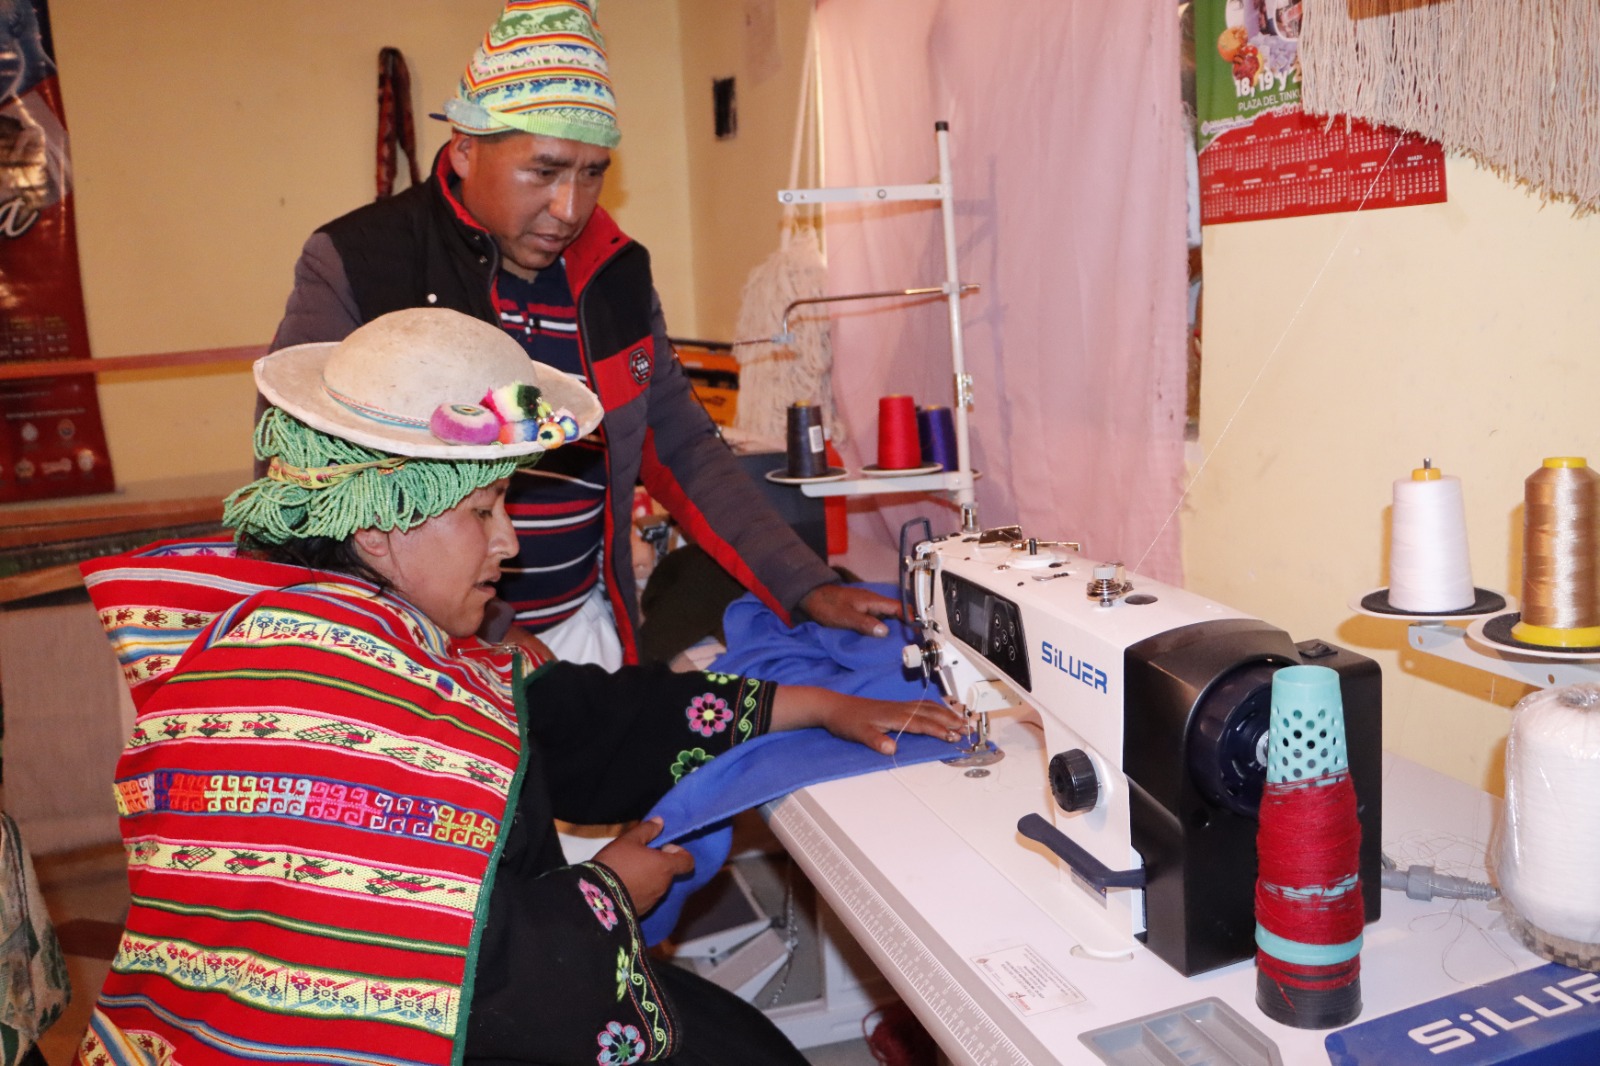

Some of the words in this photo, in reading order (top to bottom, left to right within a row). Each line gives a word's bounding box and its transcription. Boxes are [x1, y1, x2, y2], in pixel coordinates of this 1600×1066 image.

[1258, 71, 1274, 91] 19
[1238, 99, 1262, 111] PLAZA
[1263, 94, 1278, 106] DEL
[1280, 90, 1301, 101] TINK
